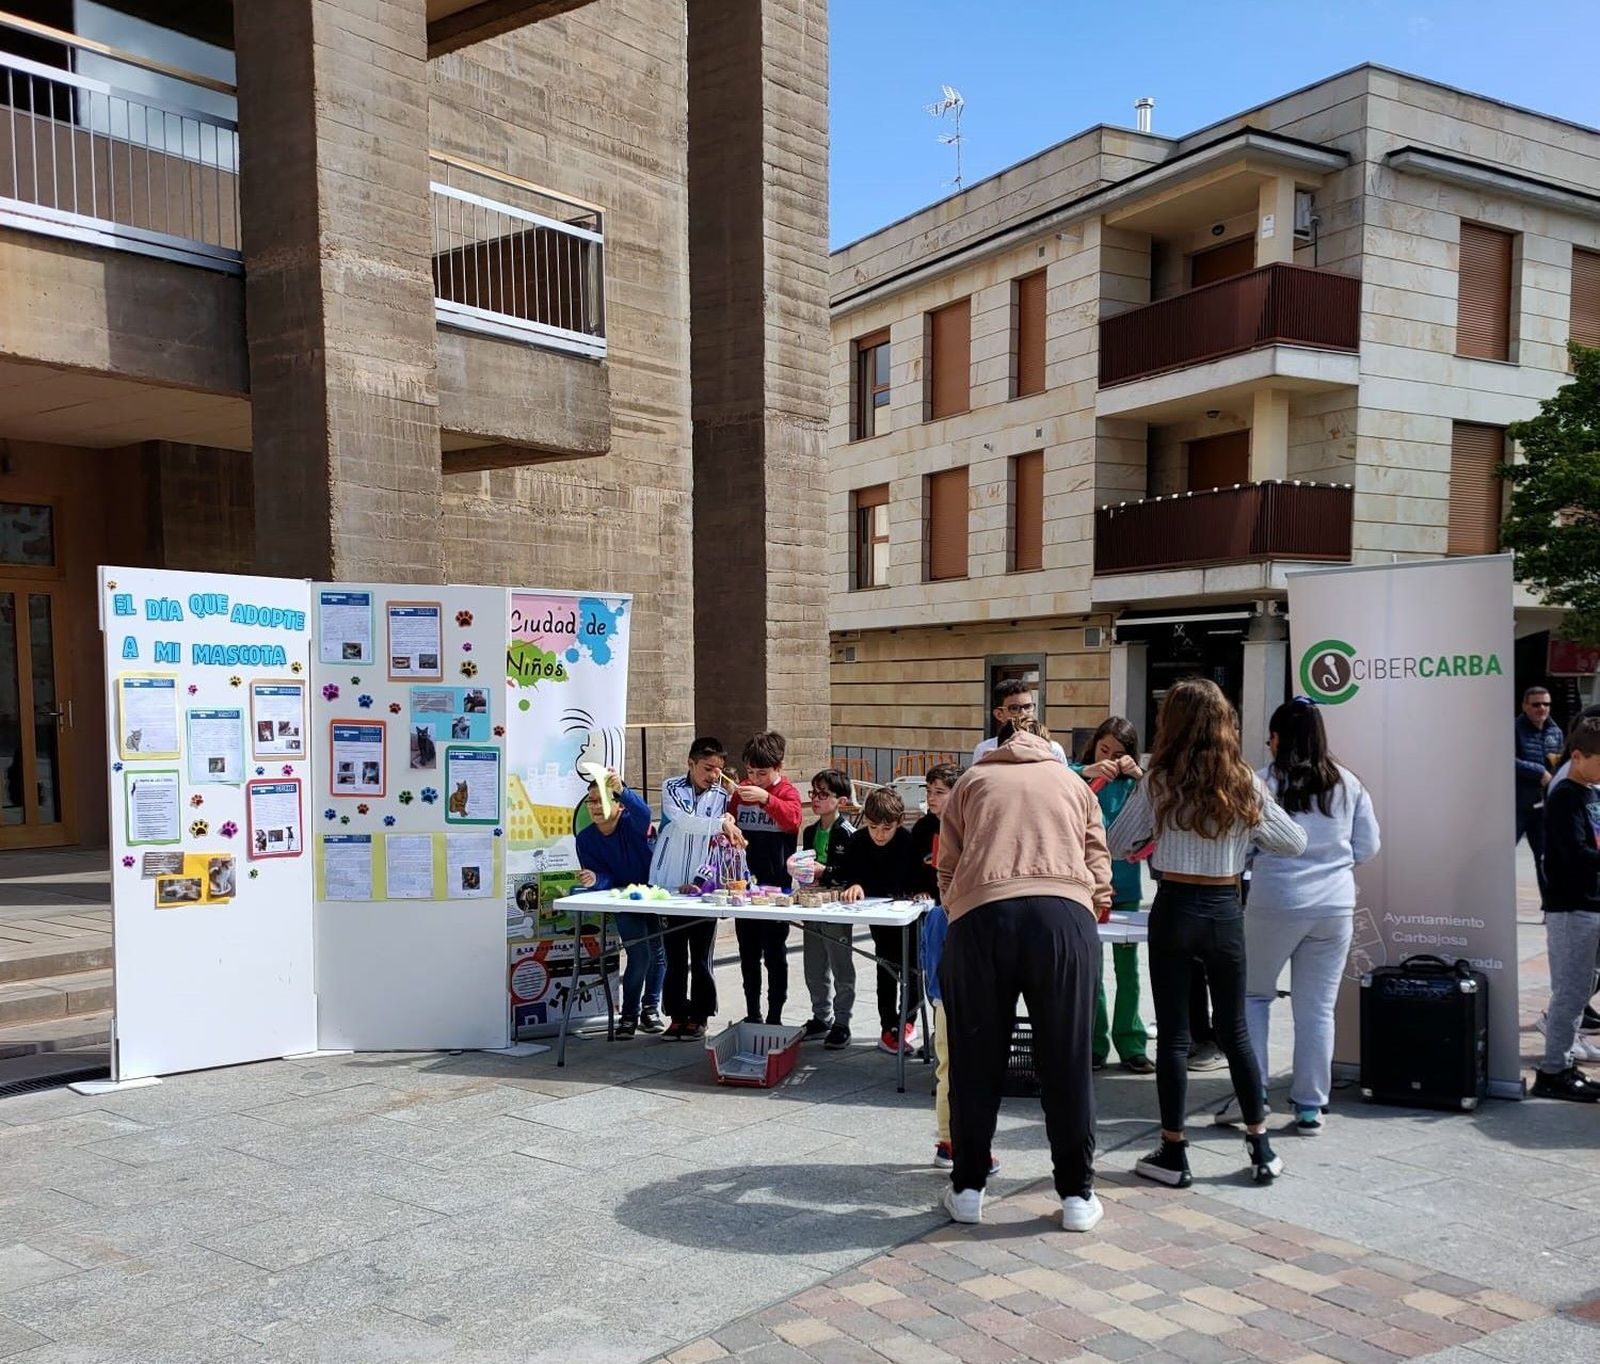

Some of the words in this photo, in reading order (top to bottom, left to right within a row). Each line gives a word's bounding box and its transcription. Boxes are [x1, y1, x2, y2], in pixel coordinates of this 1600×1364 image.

[114, 593, 137, 616] EL
[145, 597, 184, 621] DÍA
[189, 594, 229, 618] QUE
[230, 603, 306, 632] ADOPTE
[511, 609, 576, 633] Ciudad
[586, 612, 606, 635] de
[122, 635, 139, 658] A
[154, 640, 181, 663] MI
[192, 643, 287, 666] MASCOTA
[506, 650, 563, 677] Niños
[1352, 653, 1503, 681] CIBERCARBA
[1383, 911, 1485, 929] Ayuntamiento
[1391, 931, 1468, 947] Carbajosa
